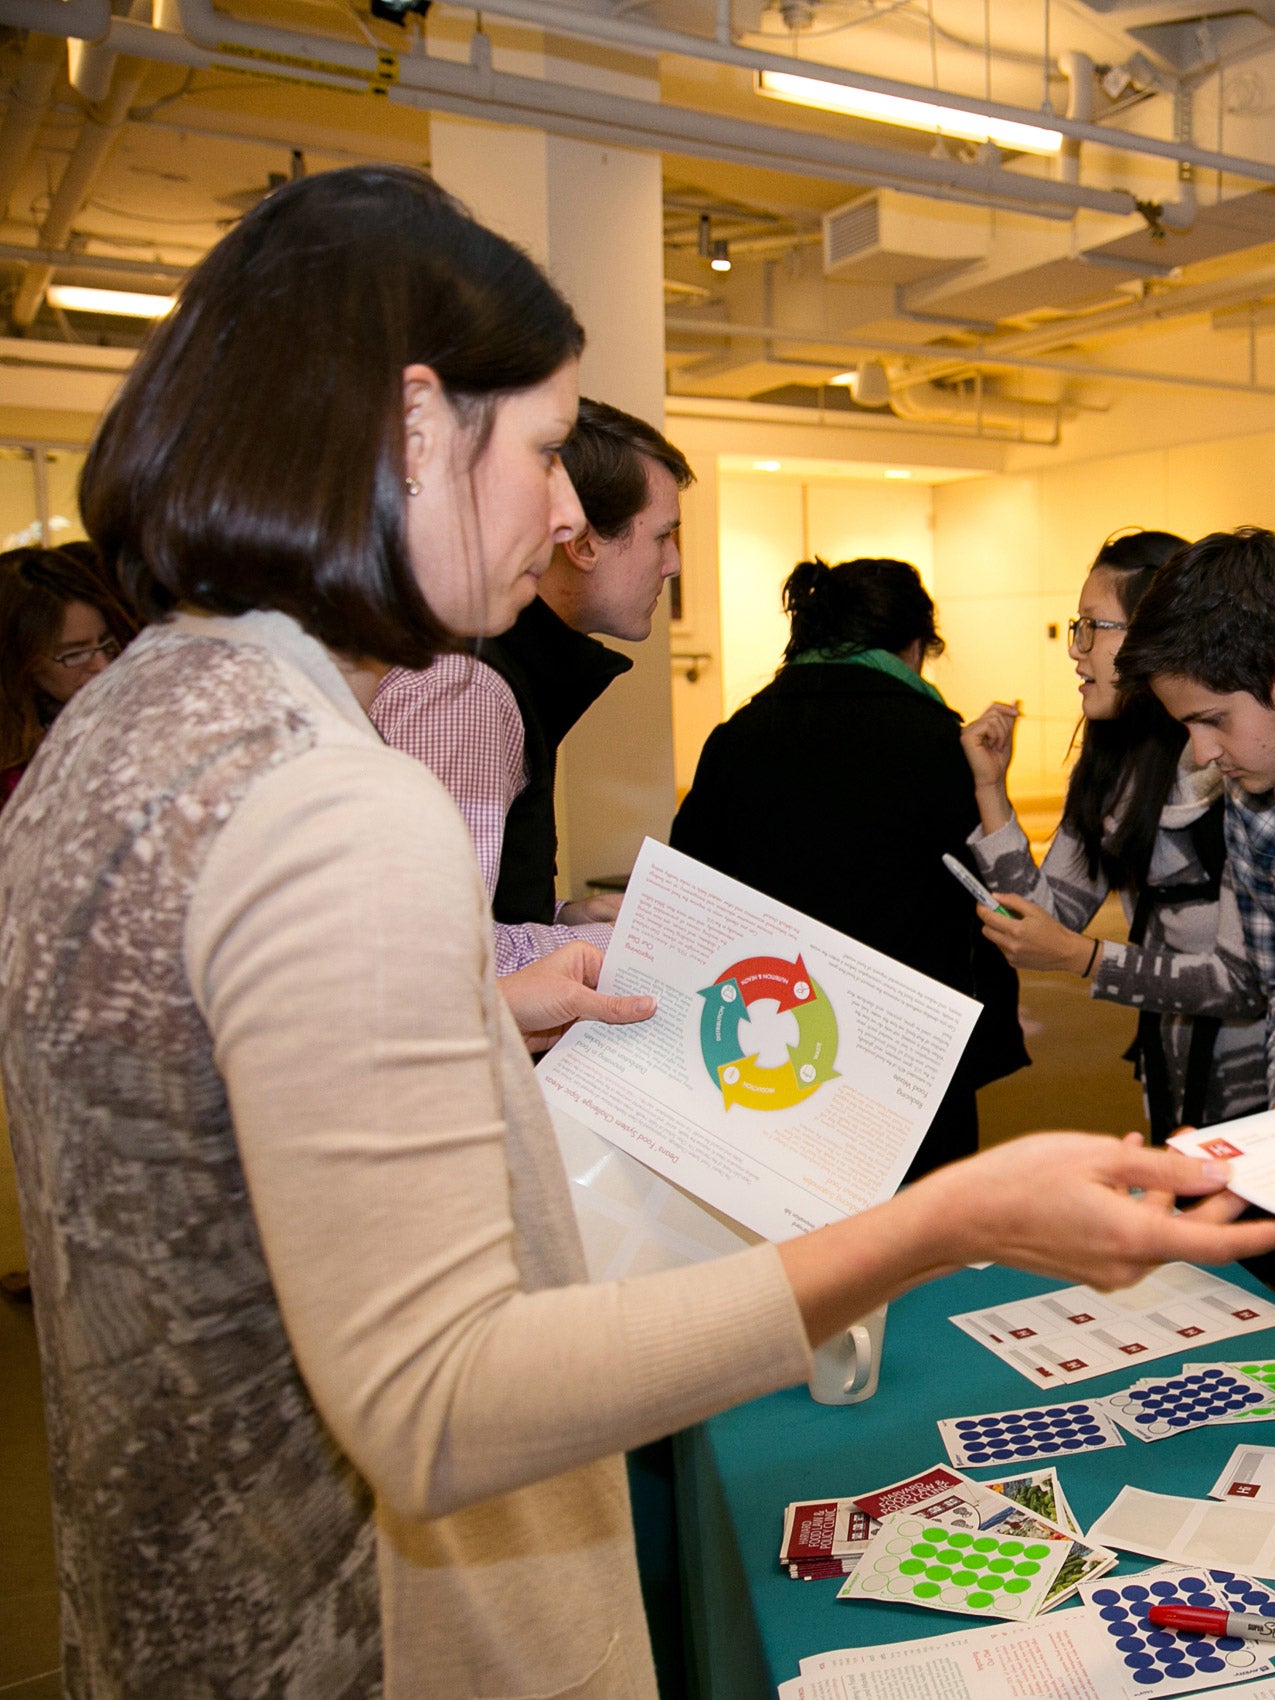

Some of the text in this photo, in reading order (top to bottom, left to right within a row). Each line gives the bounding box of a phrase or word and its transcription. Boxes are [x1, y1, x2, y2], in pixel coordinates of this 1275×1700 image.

[640, 940, 654, 950] Our
[575, 1039, 591, 1053] Food
[542, 1074, 564, 1092] Areas
[911, 1084, 929, 1097] Food
[894, 1087, 924, 1109] Reducing
[579, 1096, 615, 1123] Challenge
[613, 1116, 638, 1138] System
[636, 1133, 655, 1149] Food
[879, 1481, 922, 1501] HARVARD
[879, 1493, 910, 1508] FOOD
[912, 1483, 933, 1496] LAW
[880, 1481, 952, 1514] POLICY CLINIC
[819, 1508, 835, 1549] POLICY CLINIC
[808, 1530, 821, 1547] FOOD
[1247, 1623, 1264, 1632] SUPER
